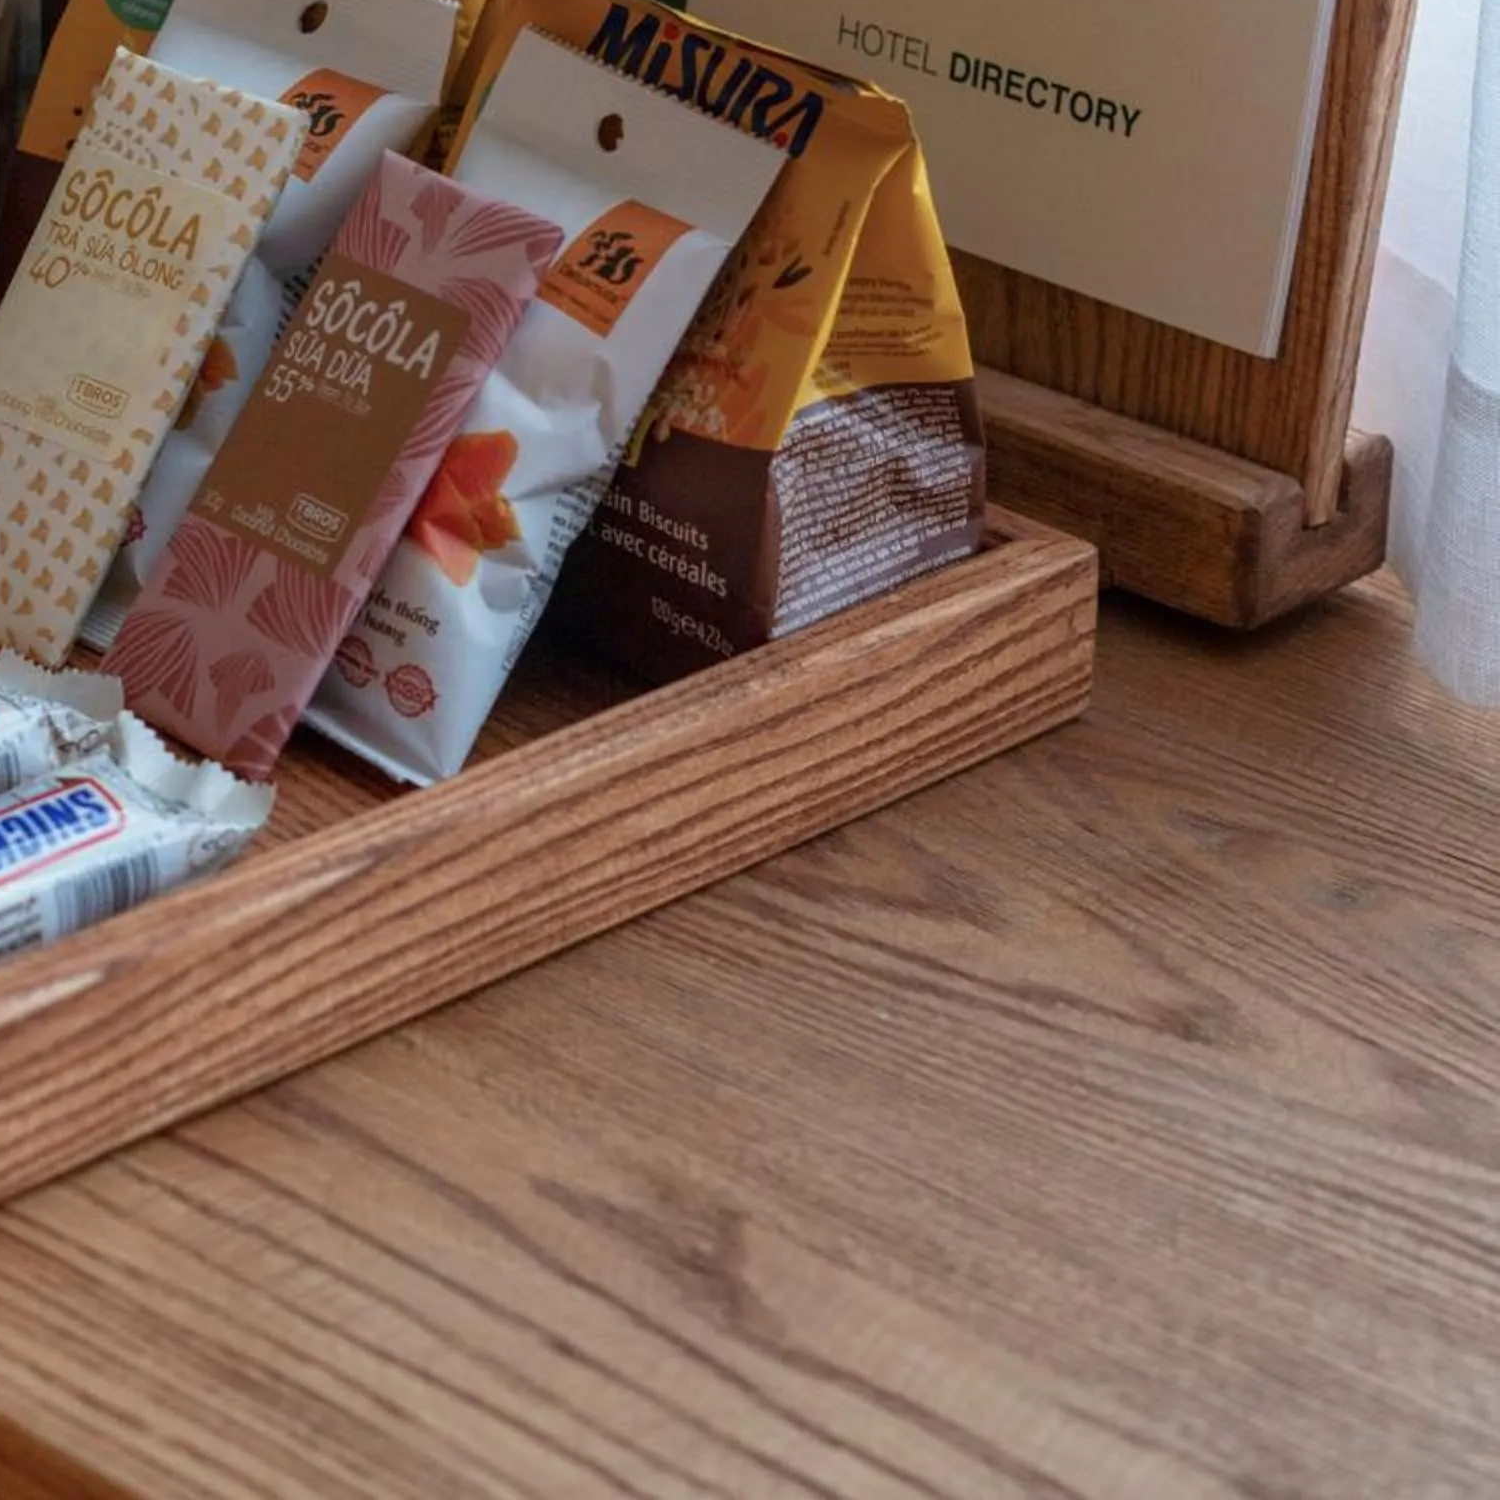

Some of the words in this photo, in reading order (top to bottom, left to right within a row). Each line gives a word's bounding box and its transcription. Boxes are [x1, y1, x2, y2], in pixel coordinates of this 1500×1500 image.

[837, 13, 939, 77] HOTEL
[949, 51, 1142, 137] DIRECTORY
[60, 169, 201, 261] SÔCÔLA
[306, 279, 441, 380] SÔCÔLA
[601, 522, 645, 558] avec
[648, 544, 728, 598] céréales
[638, 498, 709, 551] Biscuits
